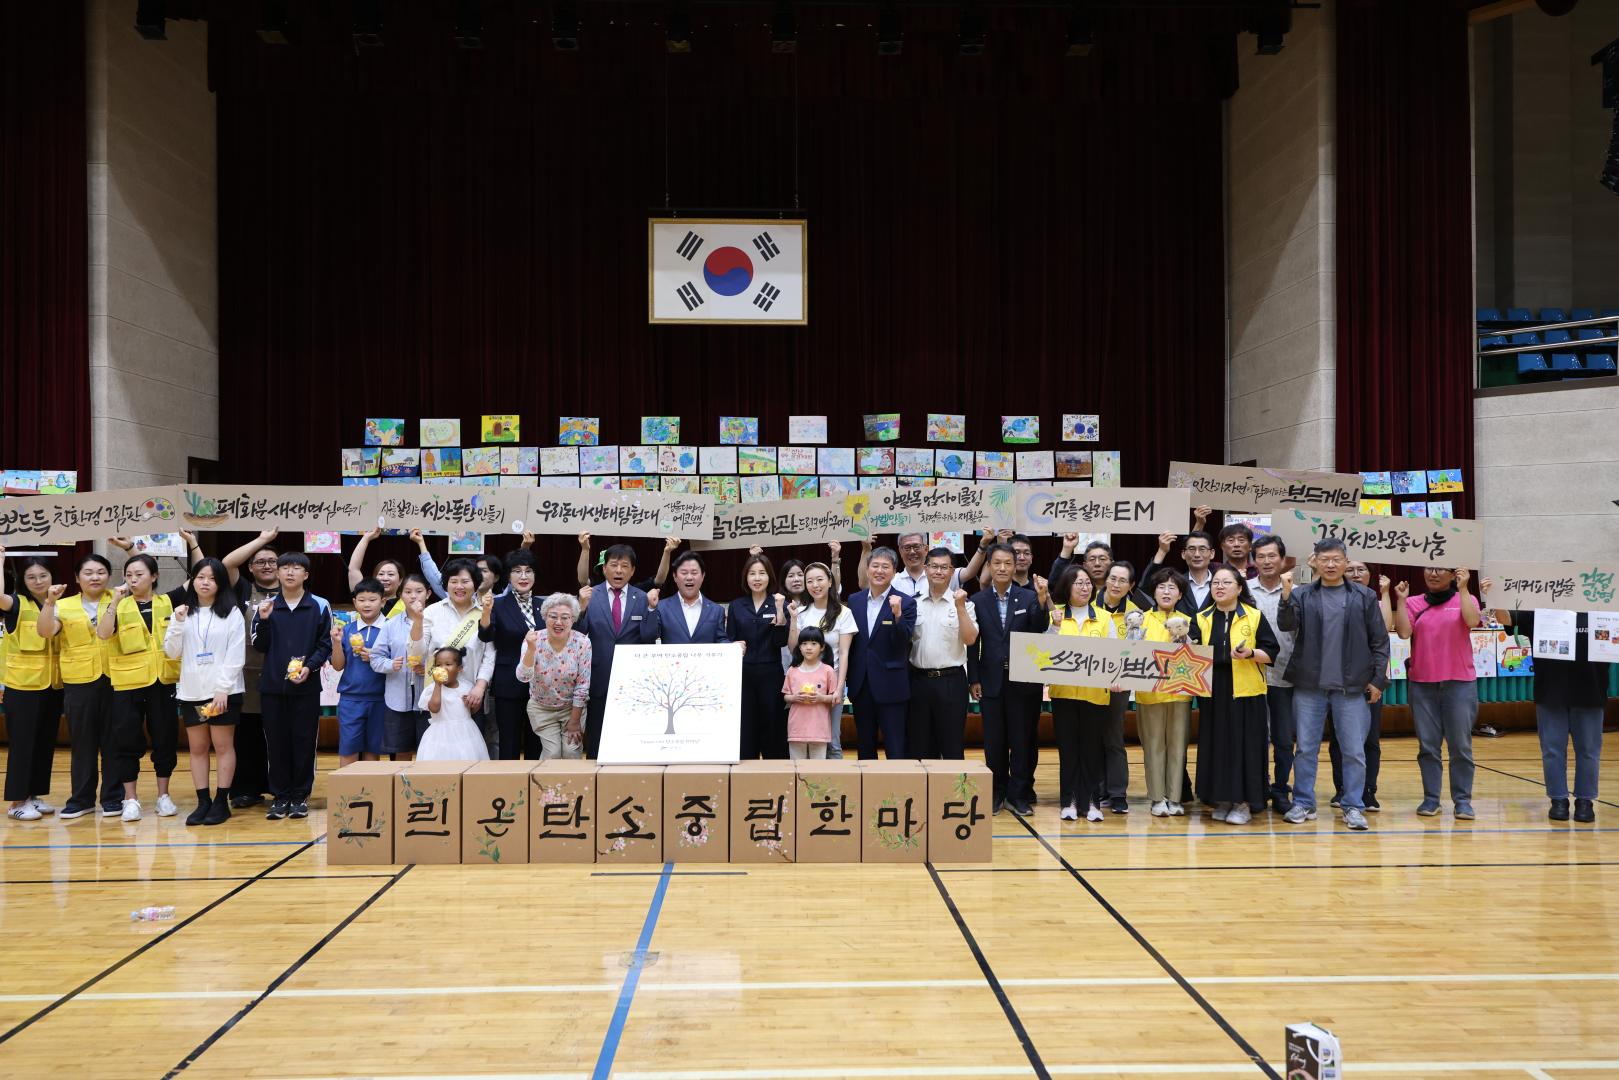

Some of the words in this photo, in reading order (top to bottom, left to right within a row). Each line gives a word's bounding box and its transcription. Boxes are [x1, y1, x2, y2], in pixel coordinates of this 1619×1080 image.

[883, 489, 922, 510] 양말목
[923, 487, 984, 507] 업사이클링
[1280, 484, 1360, 507] 보드게임
[53, 505, 103, 528] 친환경
[104, 504, 142, 532] 그림판
[215, 493, 268, 521] 폐화분
[268, 500, 324, 520] 새생명
[323, 500, 362, 525] 심어주기
[477, 505, 505, 524] 만들기
[536, 500, 587, 523] 우리동네
[587, 503, 661, 526] 생태탐험대
[1042, 499, 1078, 521] 지구를
[1078, 500, 1114, 522] 살리는
[1113, 500, 1155, 521] EM
[1412, 532, 1447, 560] 나눔
[1040, 650, 1123, 683] 쓰레기의
[1121, 656, 1171, 680] 변신
